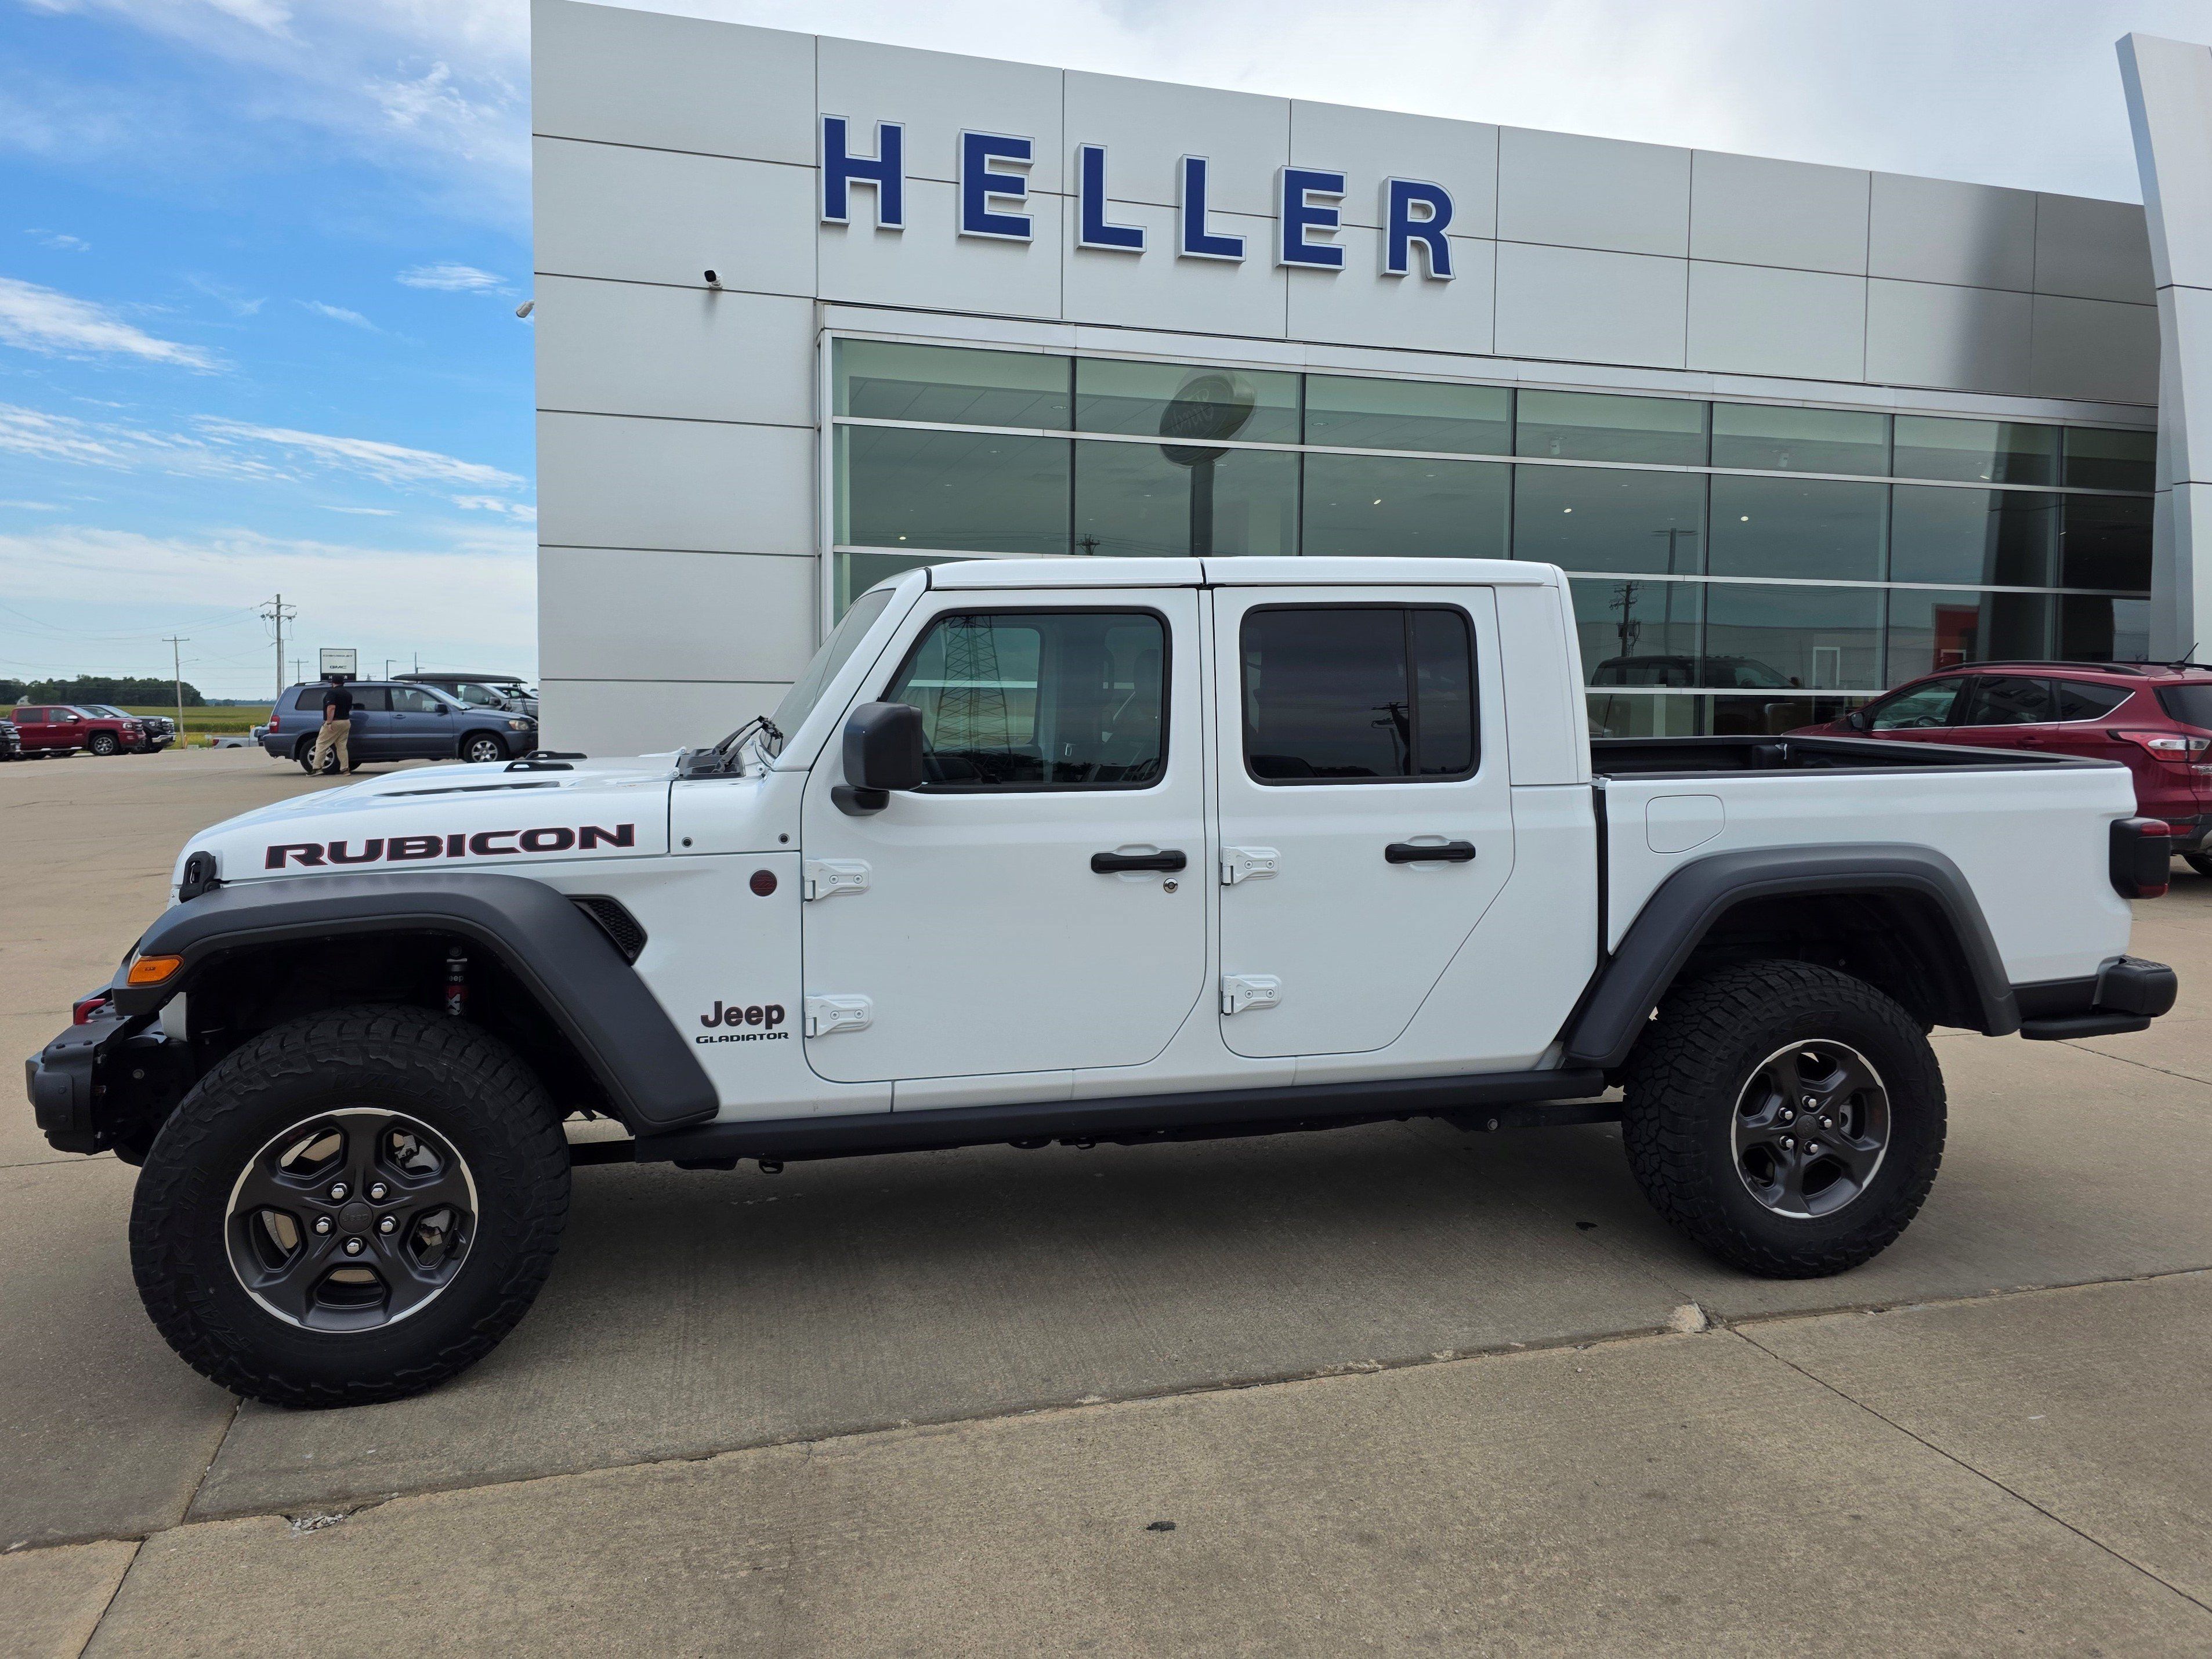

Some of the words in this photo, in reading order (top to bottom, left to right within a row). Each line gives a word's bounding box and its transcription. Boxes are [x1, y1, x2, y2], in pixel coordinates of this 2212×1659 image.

[820, 113, 1456, 282] HELLER
[265, 824, 635, 870] RUBICON
[446, 975, 465, 983] eep
[701, 1001, 785, 1030] Jeep
[696, 1032, 790, 1044] GLADIATOR
